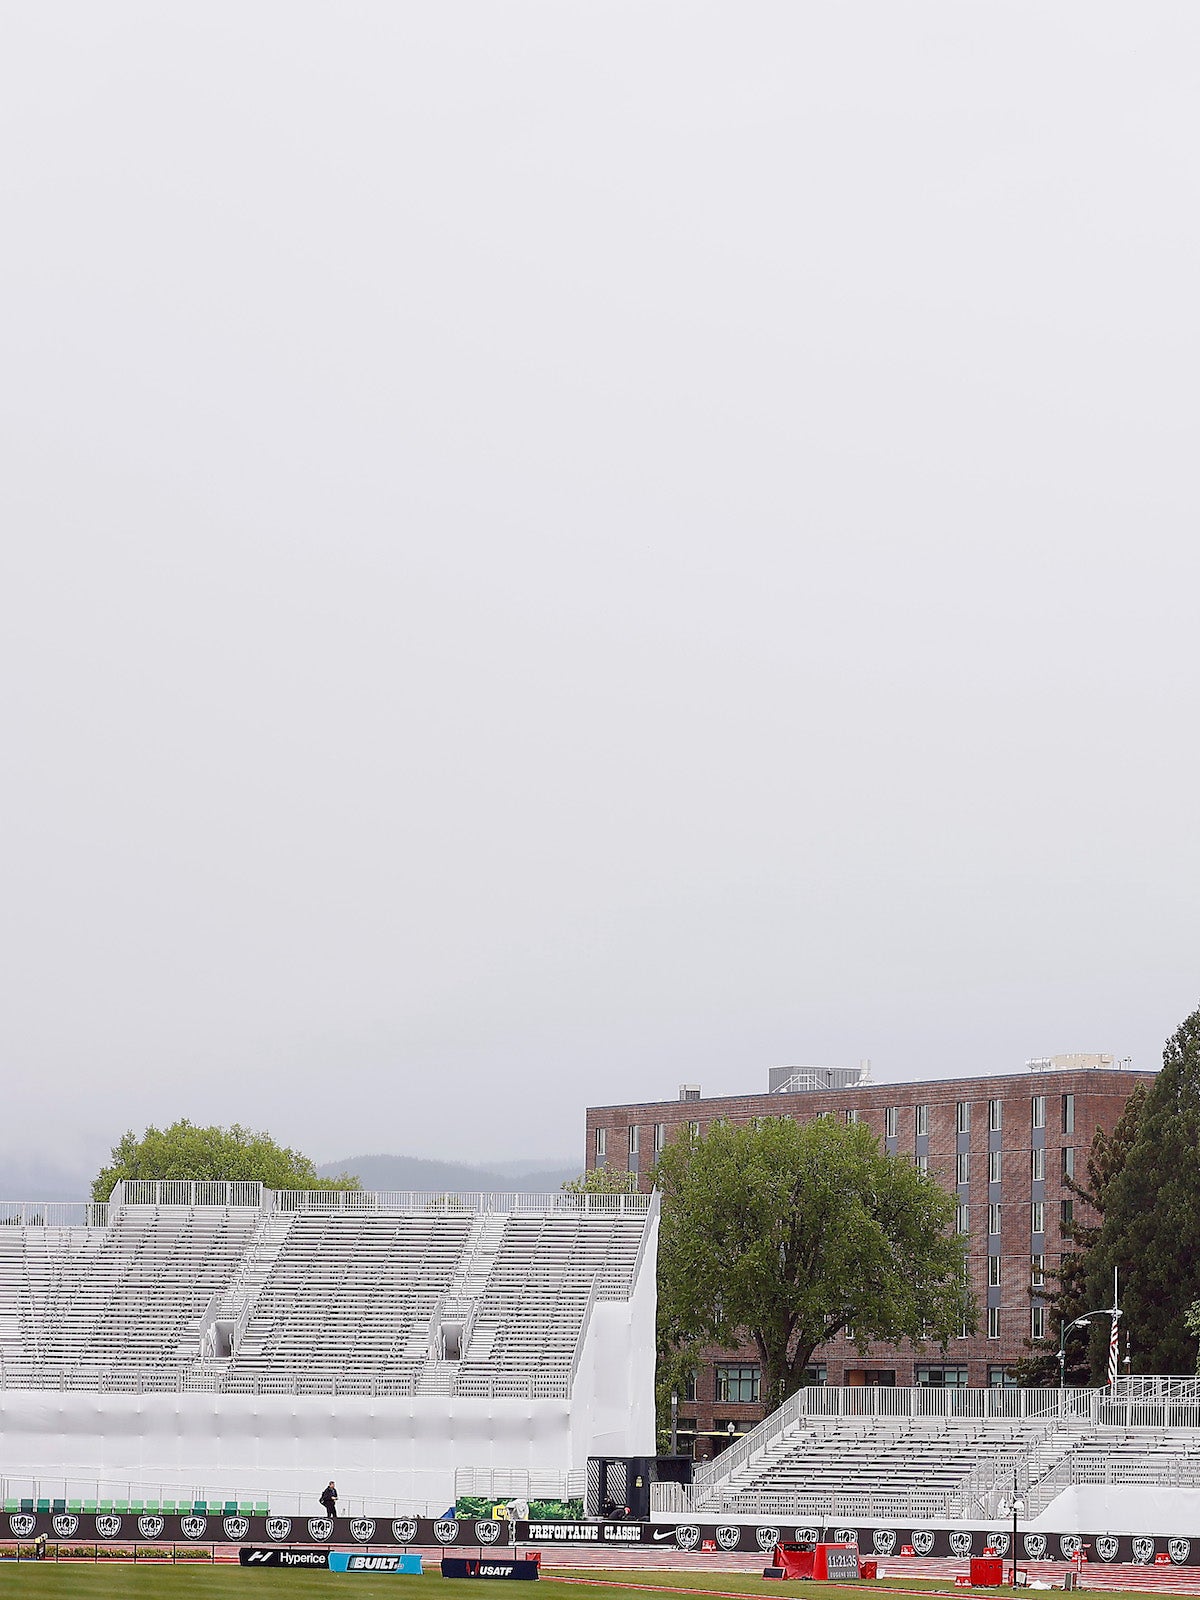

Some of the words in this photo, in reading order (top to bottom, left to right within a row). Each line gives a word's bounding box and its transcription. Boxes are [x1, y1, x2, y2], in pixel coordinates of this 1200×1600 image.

[528, 1524, 598, 1540] PREFONTAINE
[604, 1525, 641, 1541] CLASSIC
[280, 1552, 326, 1564] Hyperice
[354, 1557, 398, 1569] BUILT
[828, 1555, 857, 1568] 11:21:35
[479, 1566, 513, 1576] USATF
